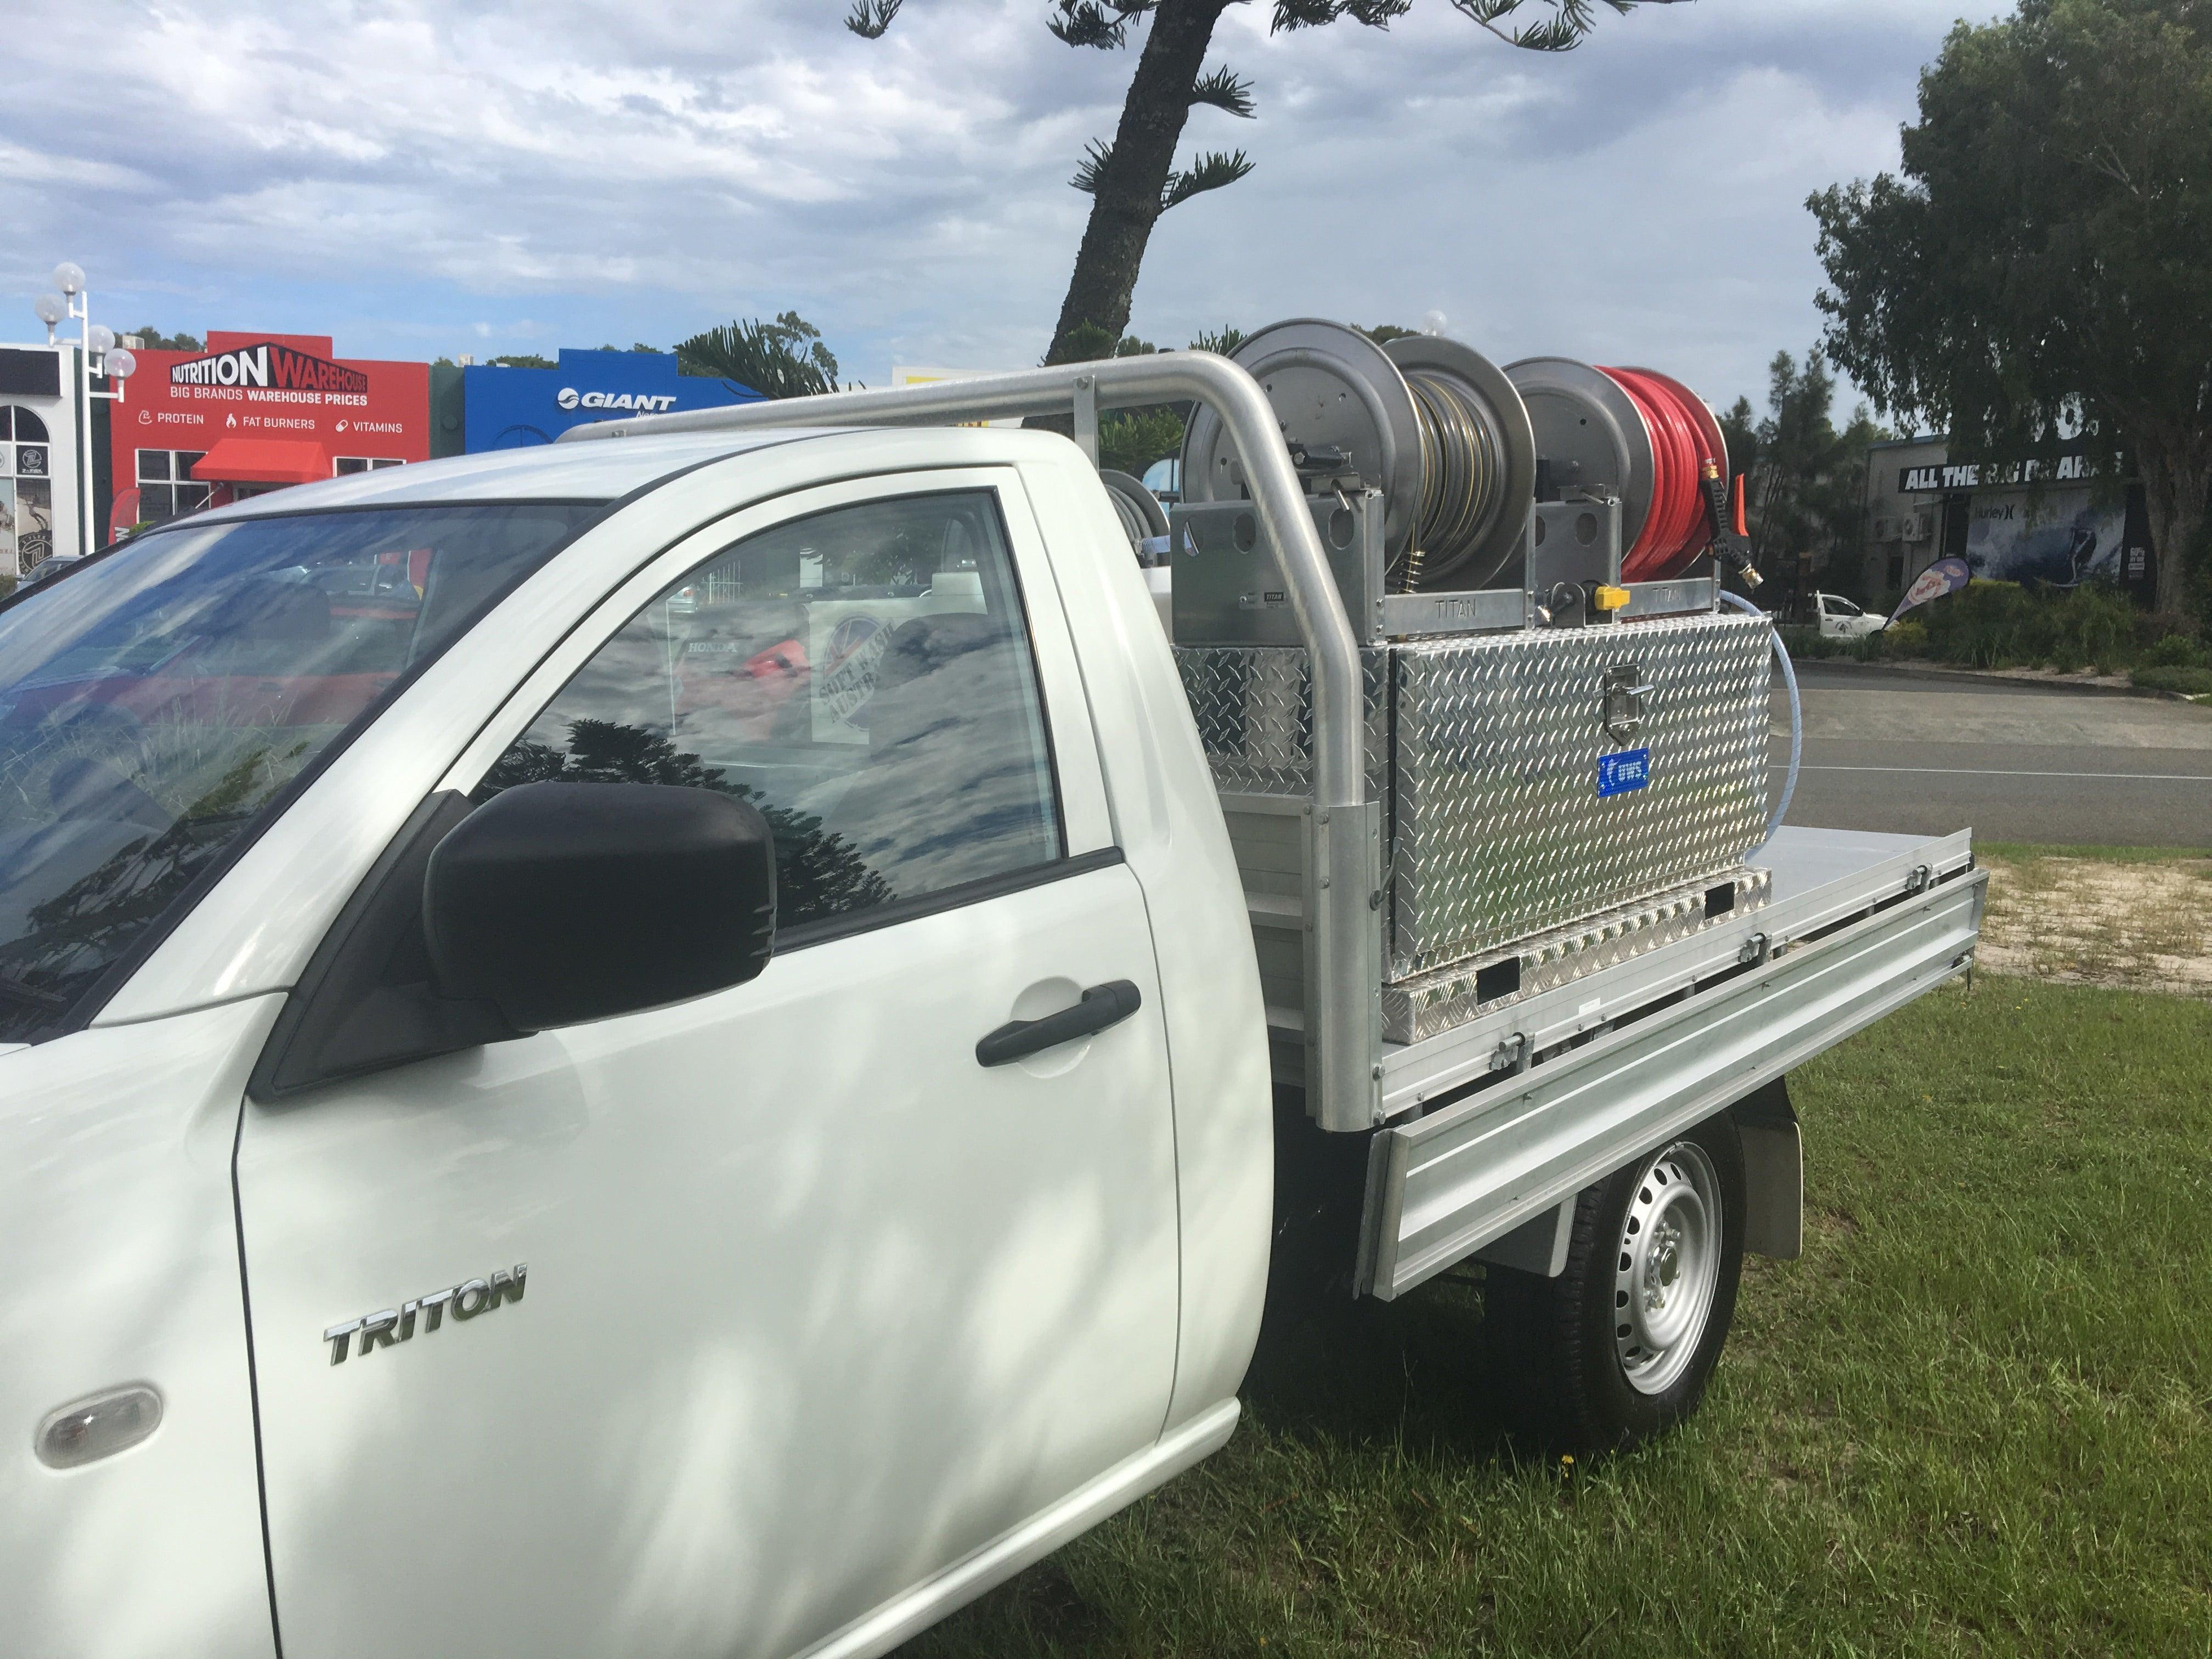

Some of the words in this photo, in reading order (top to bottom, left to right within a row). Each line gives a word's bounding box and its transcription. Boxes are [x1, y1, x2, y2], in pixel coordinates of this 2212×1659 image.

[172, 346, 268, 387] NUTRITION
[269, 348, 366, 391] WAREHOUSE
[171, 386, 189, 398] BIG
[194, 387, 242, 400] BRANDS
[247, 390, 321, 404] WAREHOUSE
[325, 393, 368, 406] PRICES
[581, 392, 676, 411] GIANT
[157, 413, 204, 424] PROTEIN
[243, 416, 261, 426] FAT
[264, 417, 315, 430] BURNERS
[353, 421, 403, 433] VITAMINS
[1905, 469, 1938, 490] ALL
[1942, 464, 1980, 487] THE
[1435, 599, 1476, 619] TITAN
[689, 642, 737, 653] HONDA
[819, 662, 856, 706] SOFT
[857, 621, 894, 670] WASH
[323, 1262, 528, 1367] TRITON
